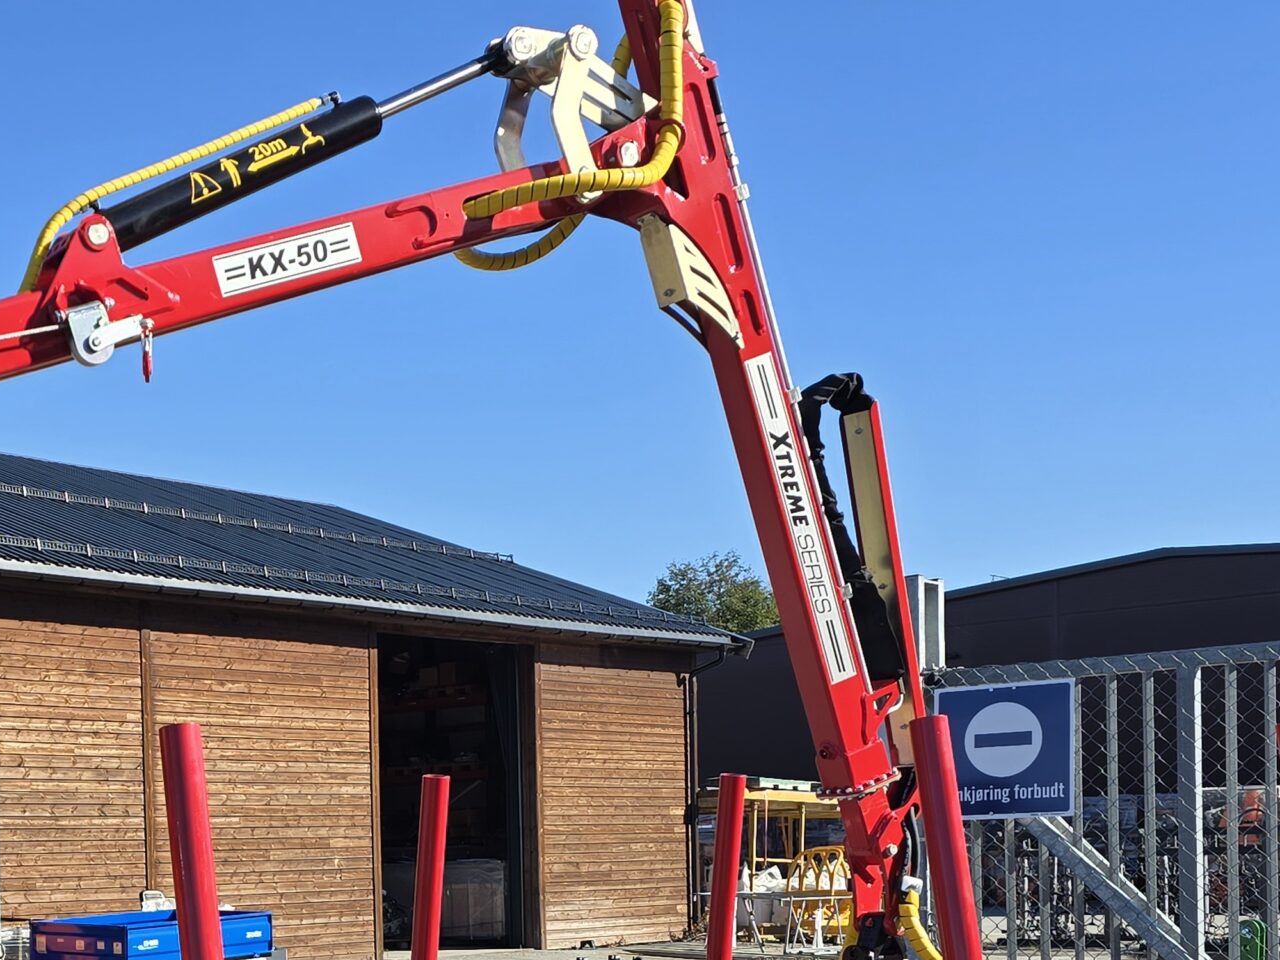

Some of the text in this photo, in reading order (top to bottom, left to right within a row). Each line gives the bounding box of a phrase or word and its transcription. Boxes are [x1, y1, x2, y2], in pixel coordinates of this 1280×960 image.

[248, 138, 288, 161] 20m
[247, 239, 328, 280] KX-50
[769, 430, 832, 614] XTREME SERIES
[958, 781, 1065, 804] nkjøring forbudt
